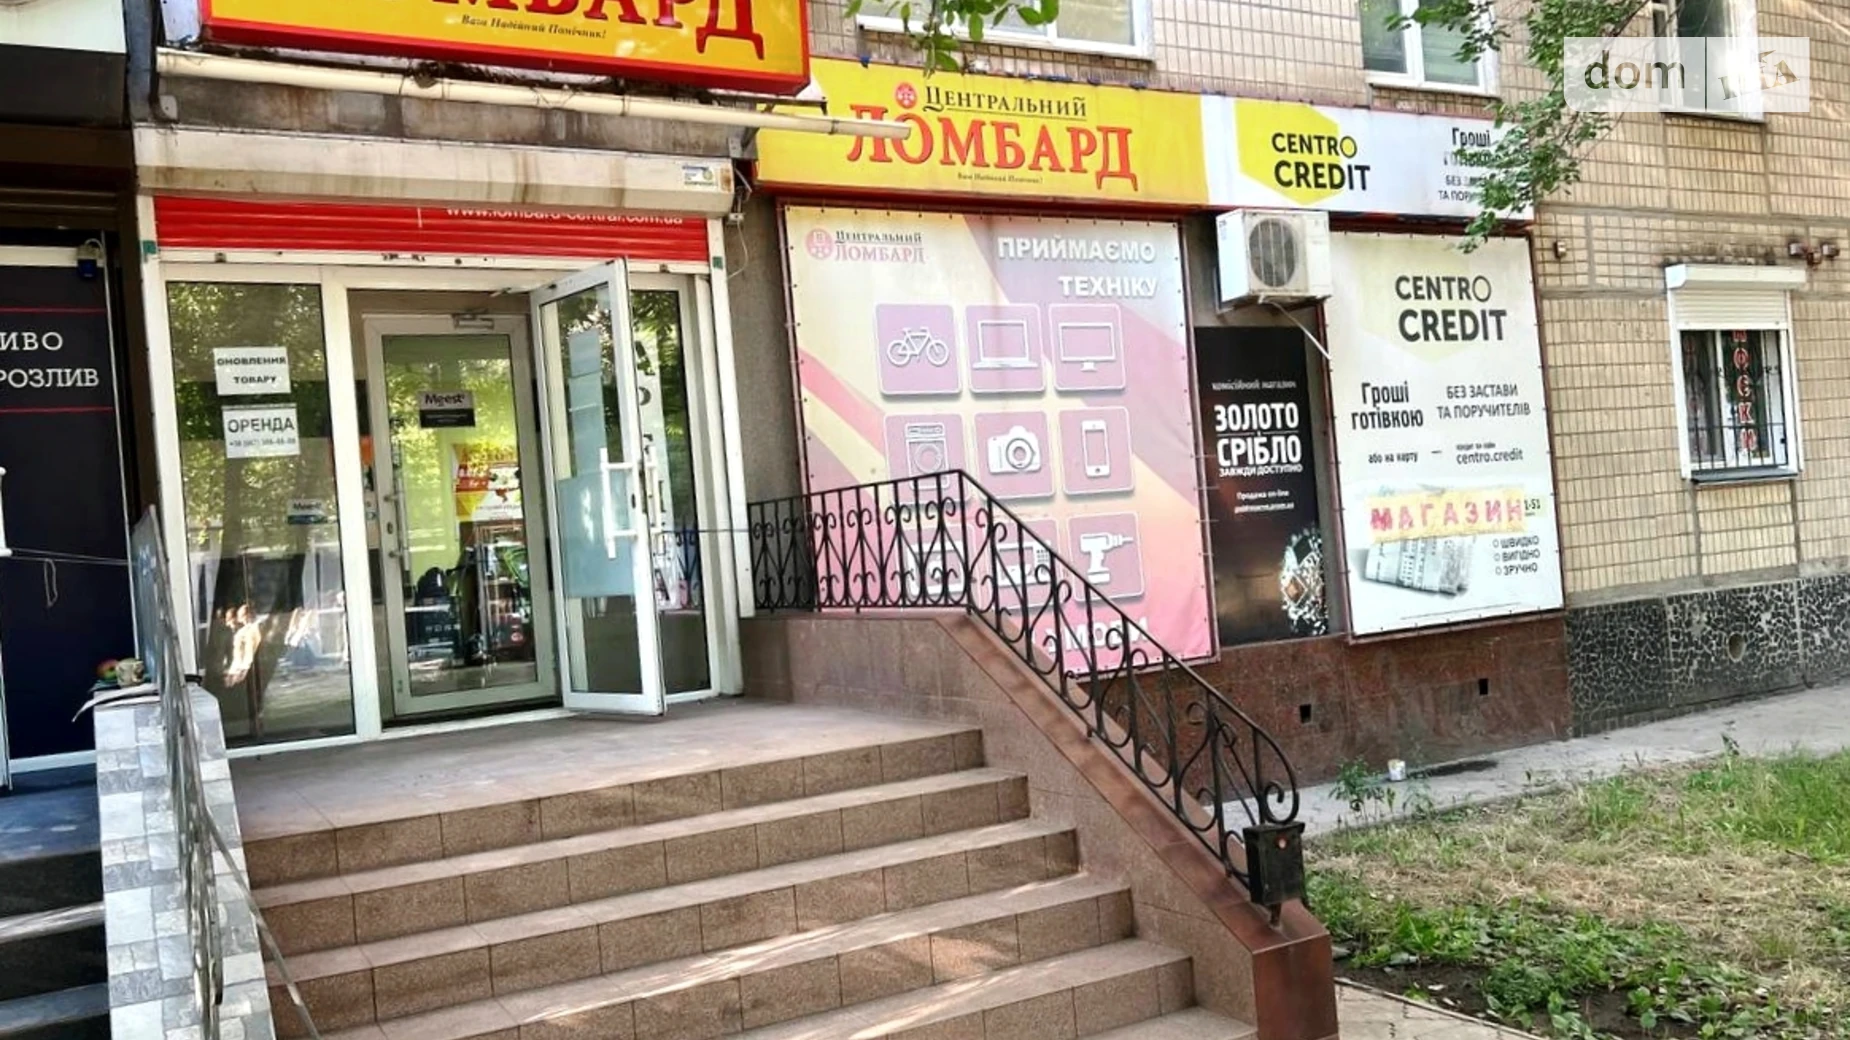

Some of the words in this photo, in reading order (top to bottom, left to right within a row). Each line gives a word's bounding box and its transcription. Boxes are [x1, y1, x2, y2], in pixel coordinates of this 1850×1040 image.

[922, 86, 1088, 118] ЦЕНТРАЛЬНИЙ
[847, 104, 1139, 191] ЛОМБАРД
[1271, 132, 1358, 159] CENTRO
[1451, 127, 1491, 147] Гроші
[1274, 159, 1371, 191] CREDIT
[835, 243, 925, 264] ЛОМБАРД
[997, 235, 1157, 263] ПРИЙМАЄМО
[1058, 275, 1159, 298] ТЕХНІКУ
[1395, 275, 1492, 302] CENTRO
[1398, 309, 1507, 342] CREDIT
[216, 356, 287, 367] ОНОВЛЕННЯ
[233, 375, 277, 385] ТОВАРУ
[1446, 385, 1467, 400] БЕЗ
[1469, 383, 1519, 399] ЗАСТАВИ
[1361, 381, 1410, 408] Гроші
[1213, 402, 1300, 432] ЗОЛОТО
[1351, 407, 1424, 430] готівкою
[1437, 406, 1452, 420] ТА
[1453, 402, 1532, 419] ПОРУЧИТЕЛІВ
[227, 417, 295, 434] ОРЕНДА
[1216, 435, 1303, 467] СРІБЛО
[1456, 448, 1524, 465] centro.credit
[1219, 466, 1256, 478] ЗАВЖДИ
[1257, 464, 1304, 477] ДОСТУПНО
[1370, 498, 1523, 531] МАГАЗИН
[1499, 535, 1540, 549] ШВИДКО
[1503, 562, 1539, 576] ЗРУЧНО
